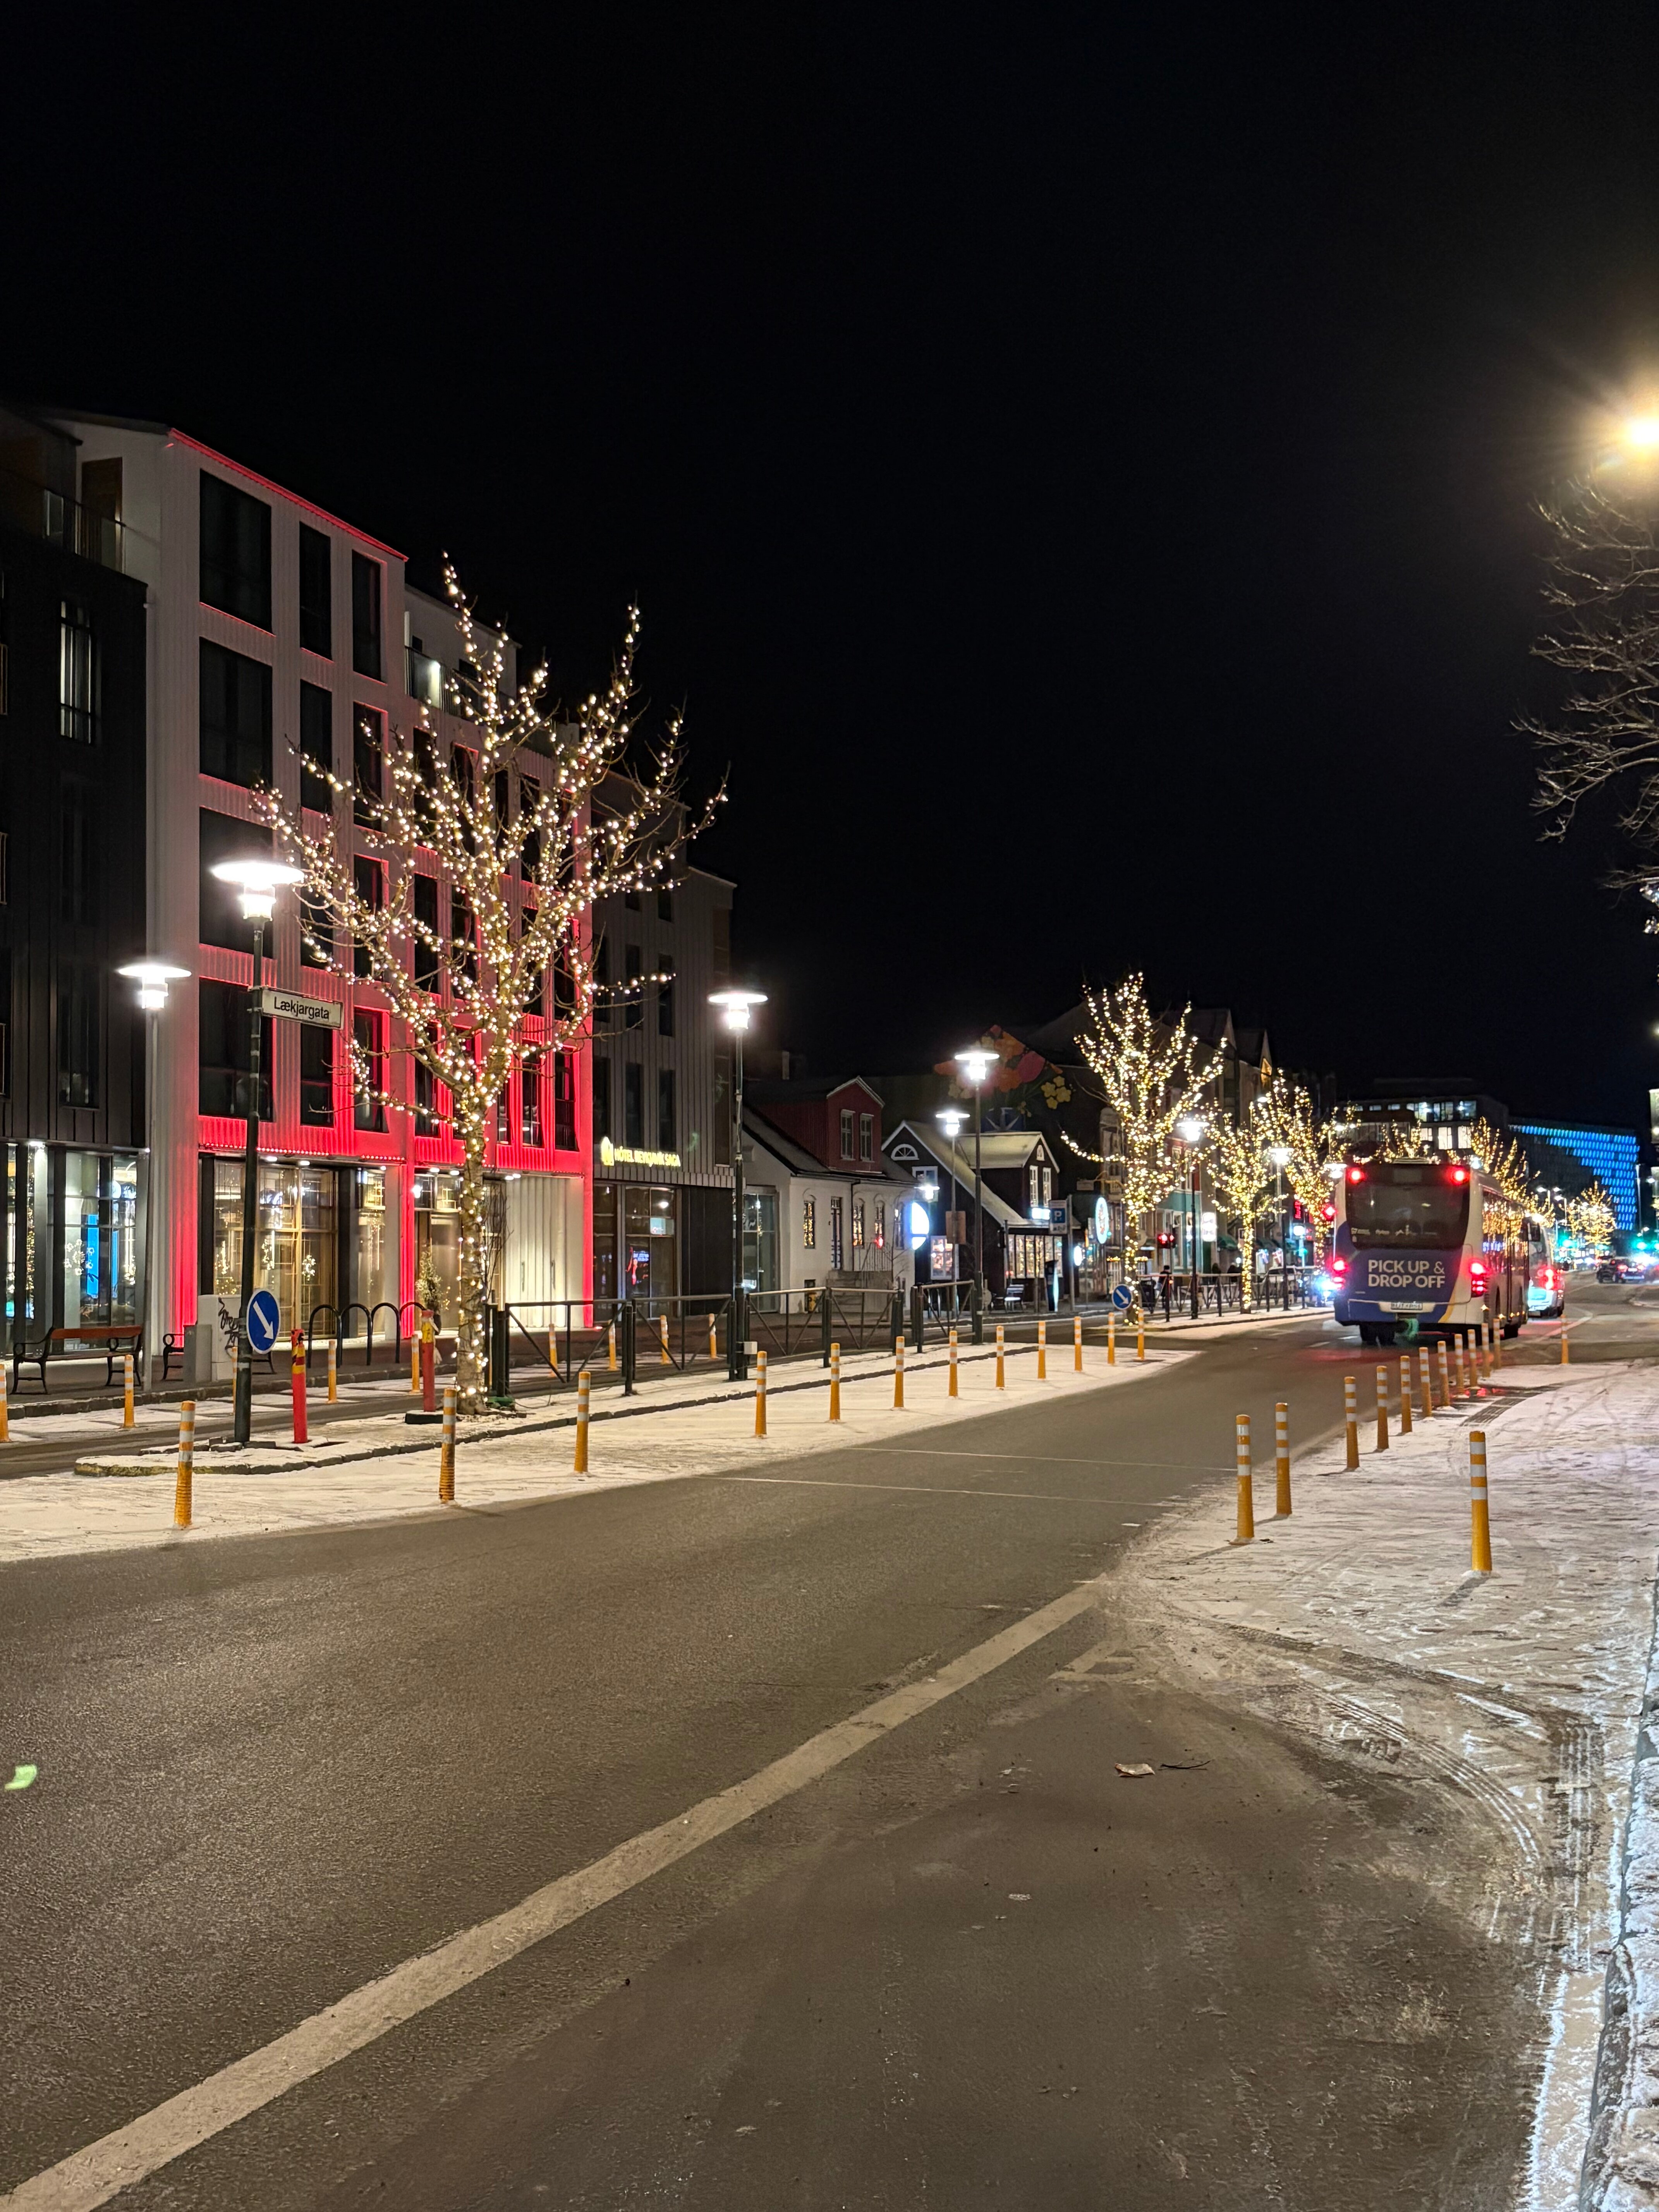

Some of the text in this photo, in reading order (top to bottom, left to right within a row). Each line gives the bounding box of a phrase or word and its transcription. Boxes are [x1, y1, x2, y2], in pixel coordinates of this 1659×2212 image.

[274, 996, 329, 1020] Lækjargata
[614, 1146, 634, 1163] HÓTEL
[665, 1153, 681, 1167] SAGA
[1054, 1210, 1062, 1221] P
[1368, 1259, 1445, 1274] PICK UP &
[1368, 1274, 1446, 1288] DROP OFF
